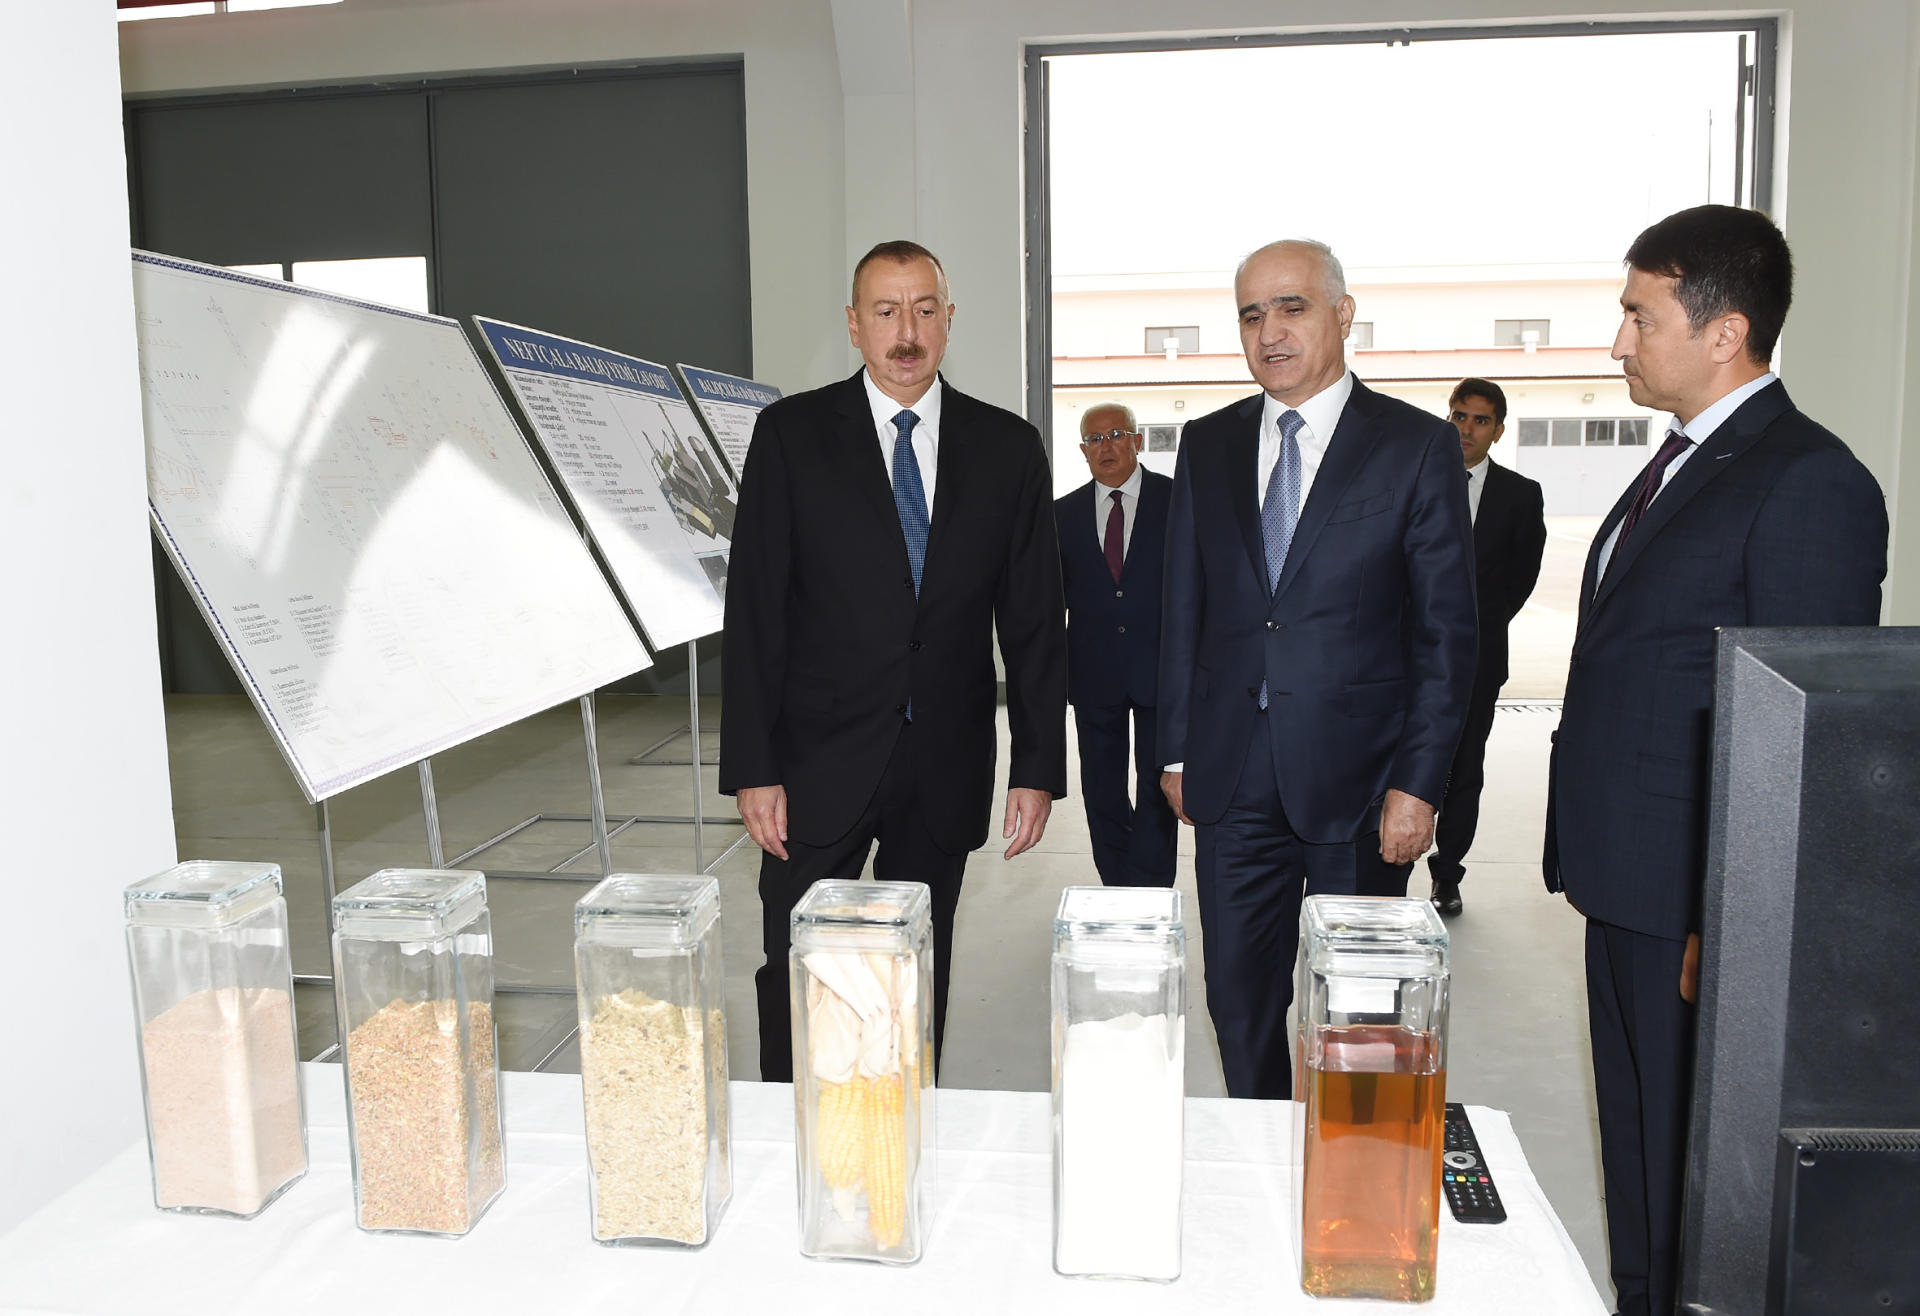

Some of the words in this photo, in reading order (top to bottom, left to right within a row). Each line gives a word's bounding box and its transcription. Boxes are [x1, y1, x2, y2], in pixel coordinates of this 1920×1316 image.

[502, 337, 575, 369] NEFTÇALA
[573, 352, 614, 382] BALIQ
[632, 369, 671, 391] ZAVODU
